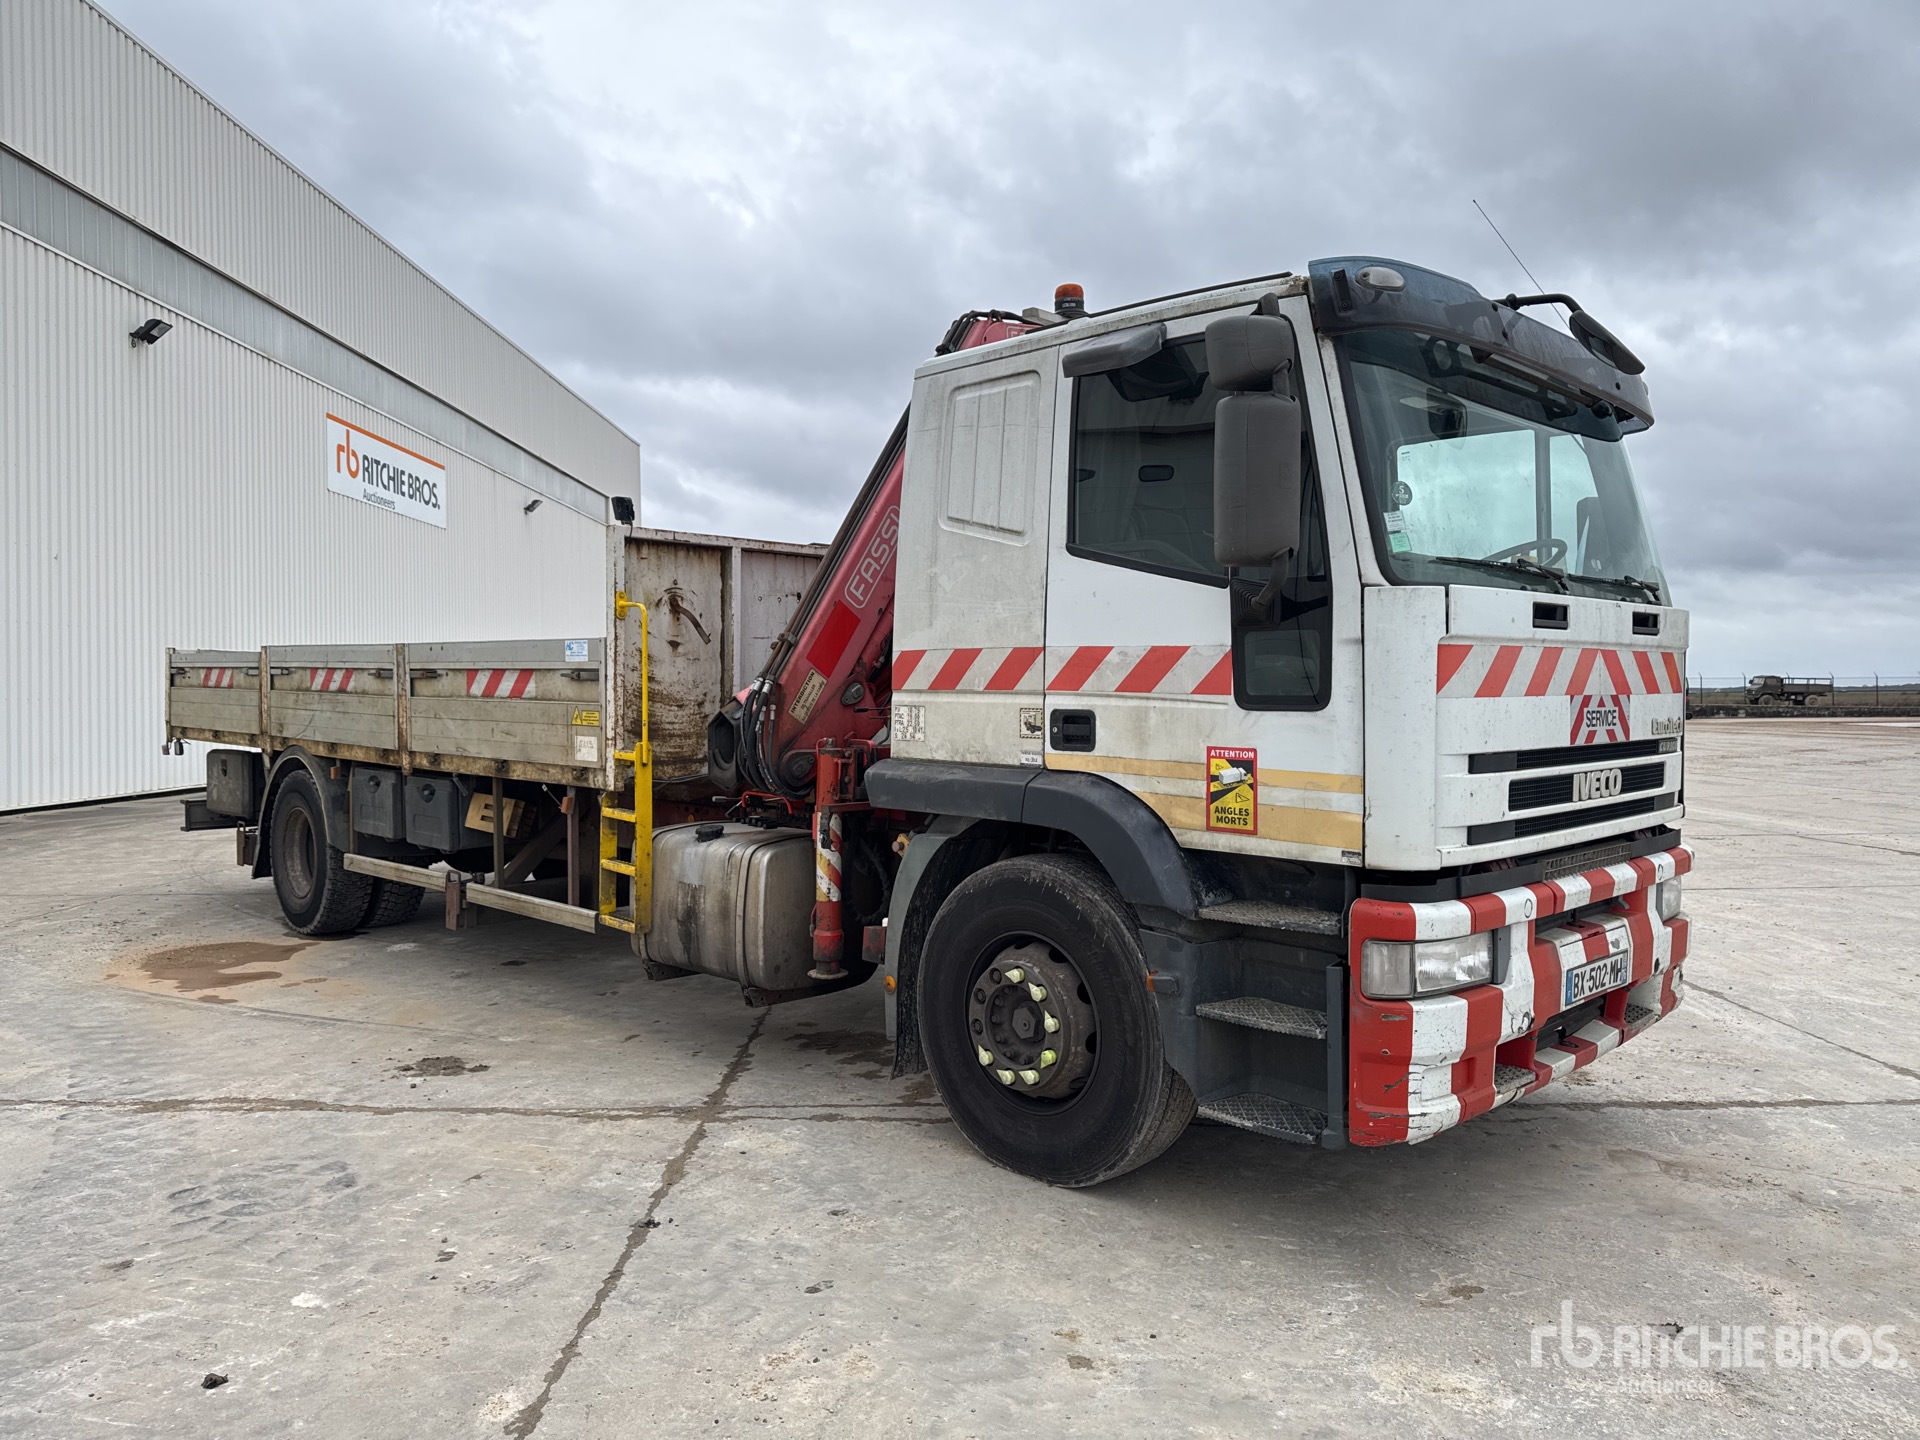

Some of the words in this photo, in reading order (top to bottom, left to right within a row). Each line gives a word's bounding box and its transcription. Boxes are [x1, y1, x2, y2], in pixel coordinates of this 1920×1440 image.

[362, 454, 406, 498] RITCHIE
[407, 472, 441, 510] BROS.
[362, 488, 396, 510] Auctioneers
[849, 512, 900, 601] FASSI
[790, 671, 815, 713] INTERDICTION
[1585, 709, 1617, 728] SERVICE
[1210, 749, 1255, 759] ATTENTION
[1572, 768, 1622, 802] IVECO
[1214, 805, 1250, 817] ANGLES
[1216, 815, 1248, 826] MORTS
